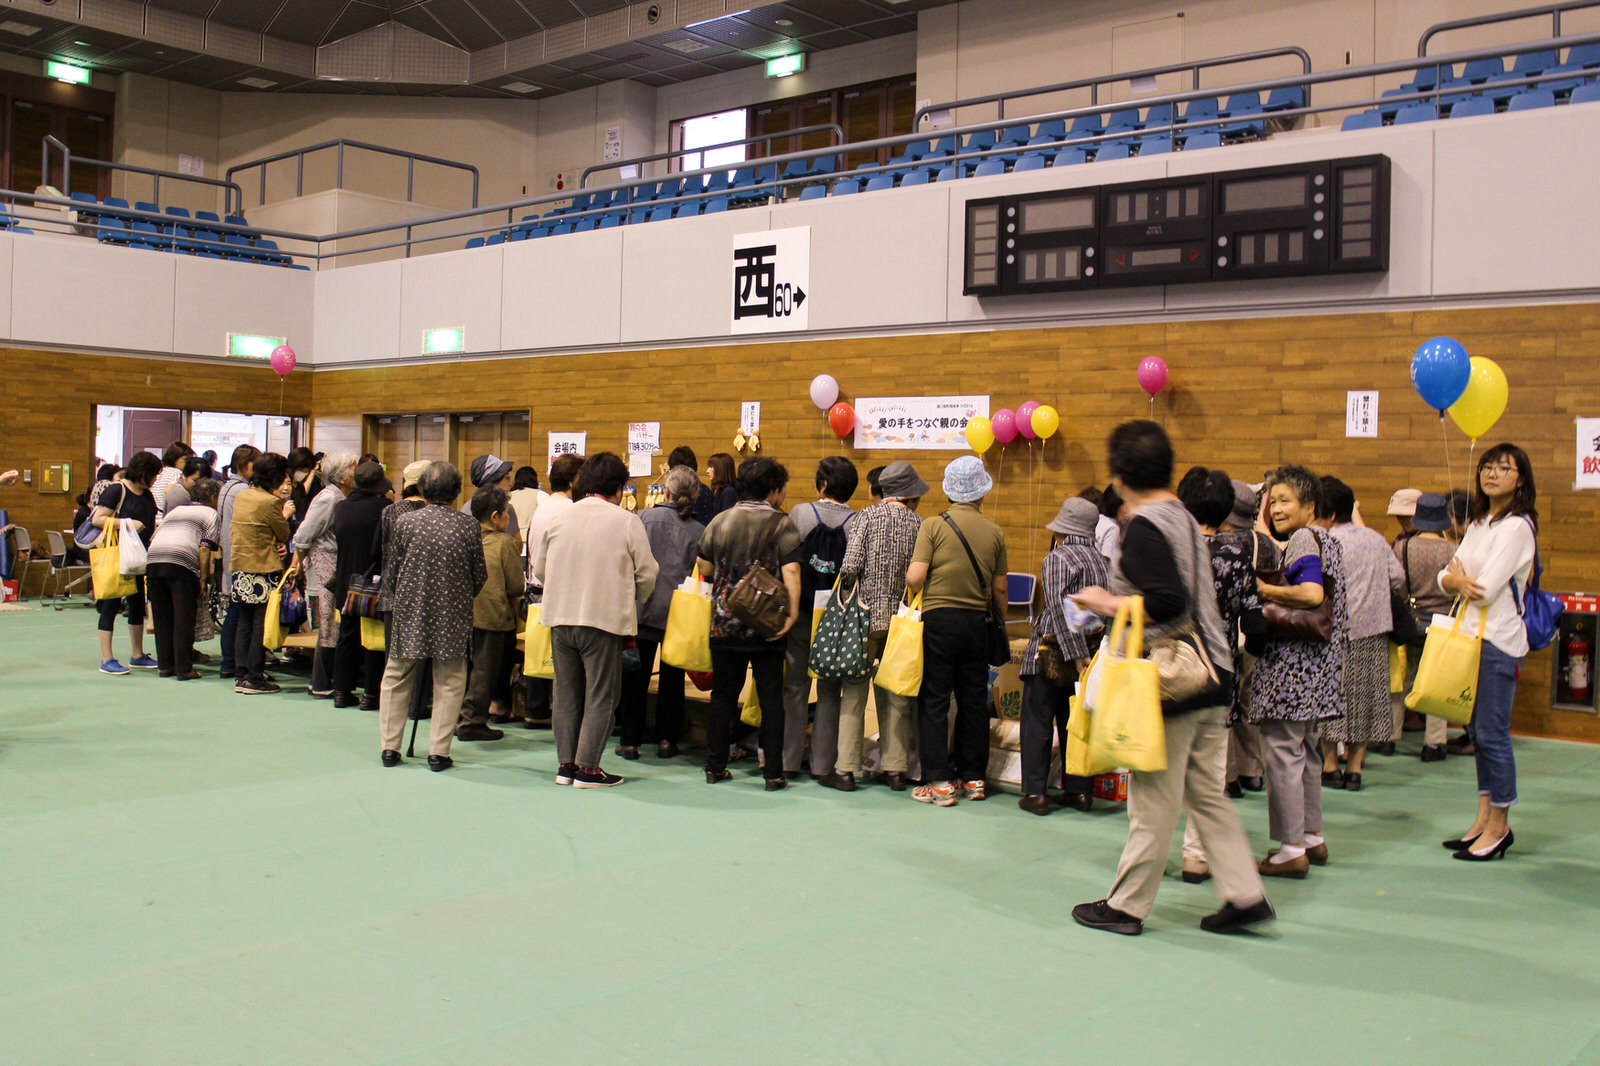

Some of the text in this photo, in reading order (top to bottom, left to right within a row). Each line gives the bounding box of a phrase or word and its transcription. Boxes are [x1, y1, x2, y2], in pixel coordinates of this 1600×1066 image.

[733, 244, 792, 321] 西 60
[878, 416, 969, 429] 愛の手をつなぐ親の会
[554, 441, 577, 454] 会場内
